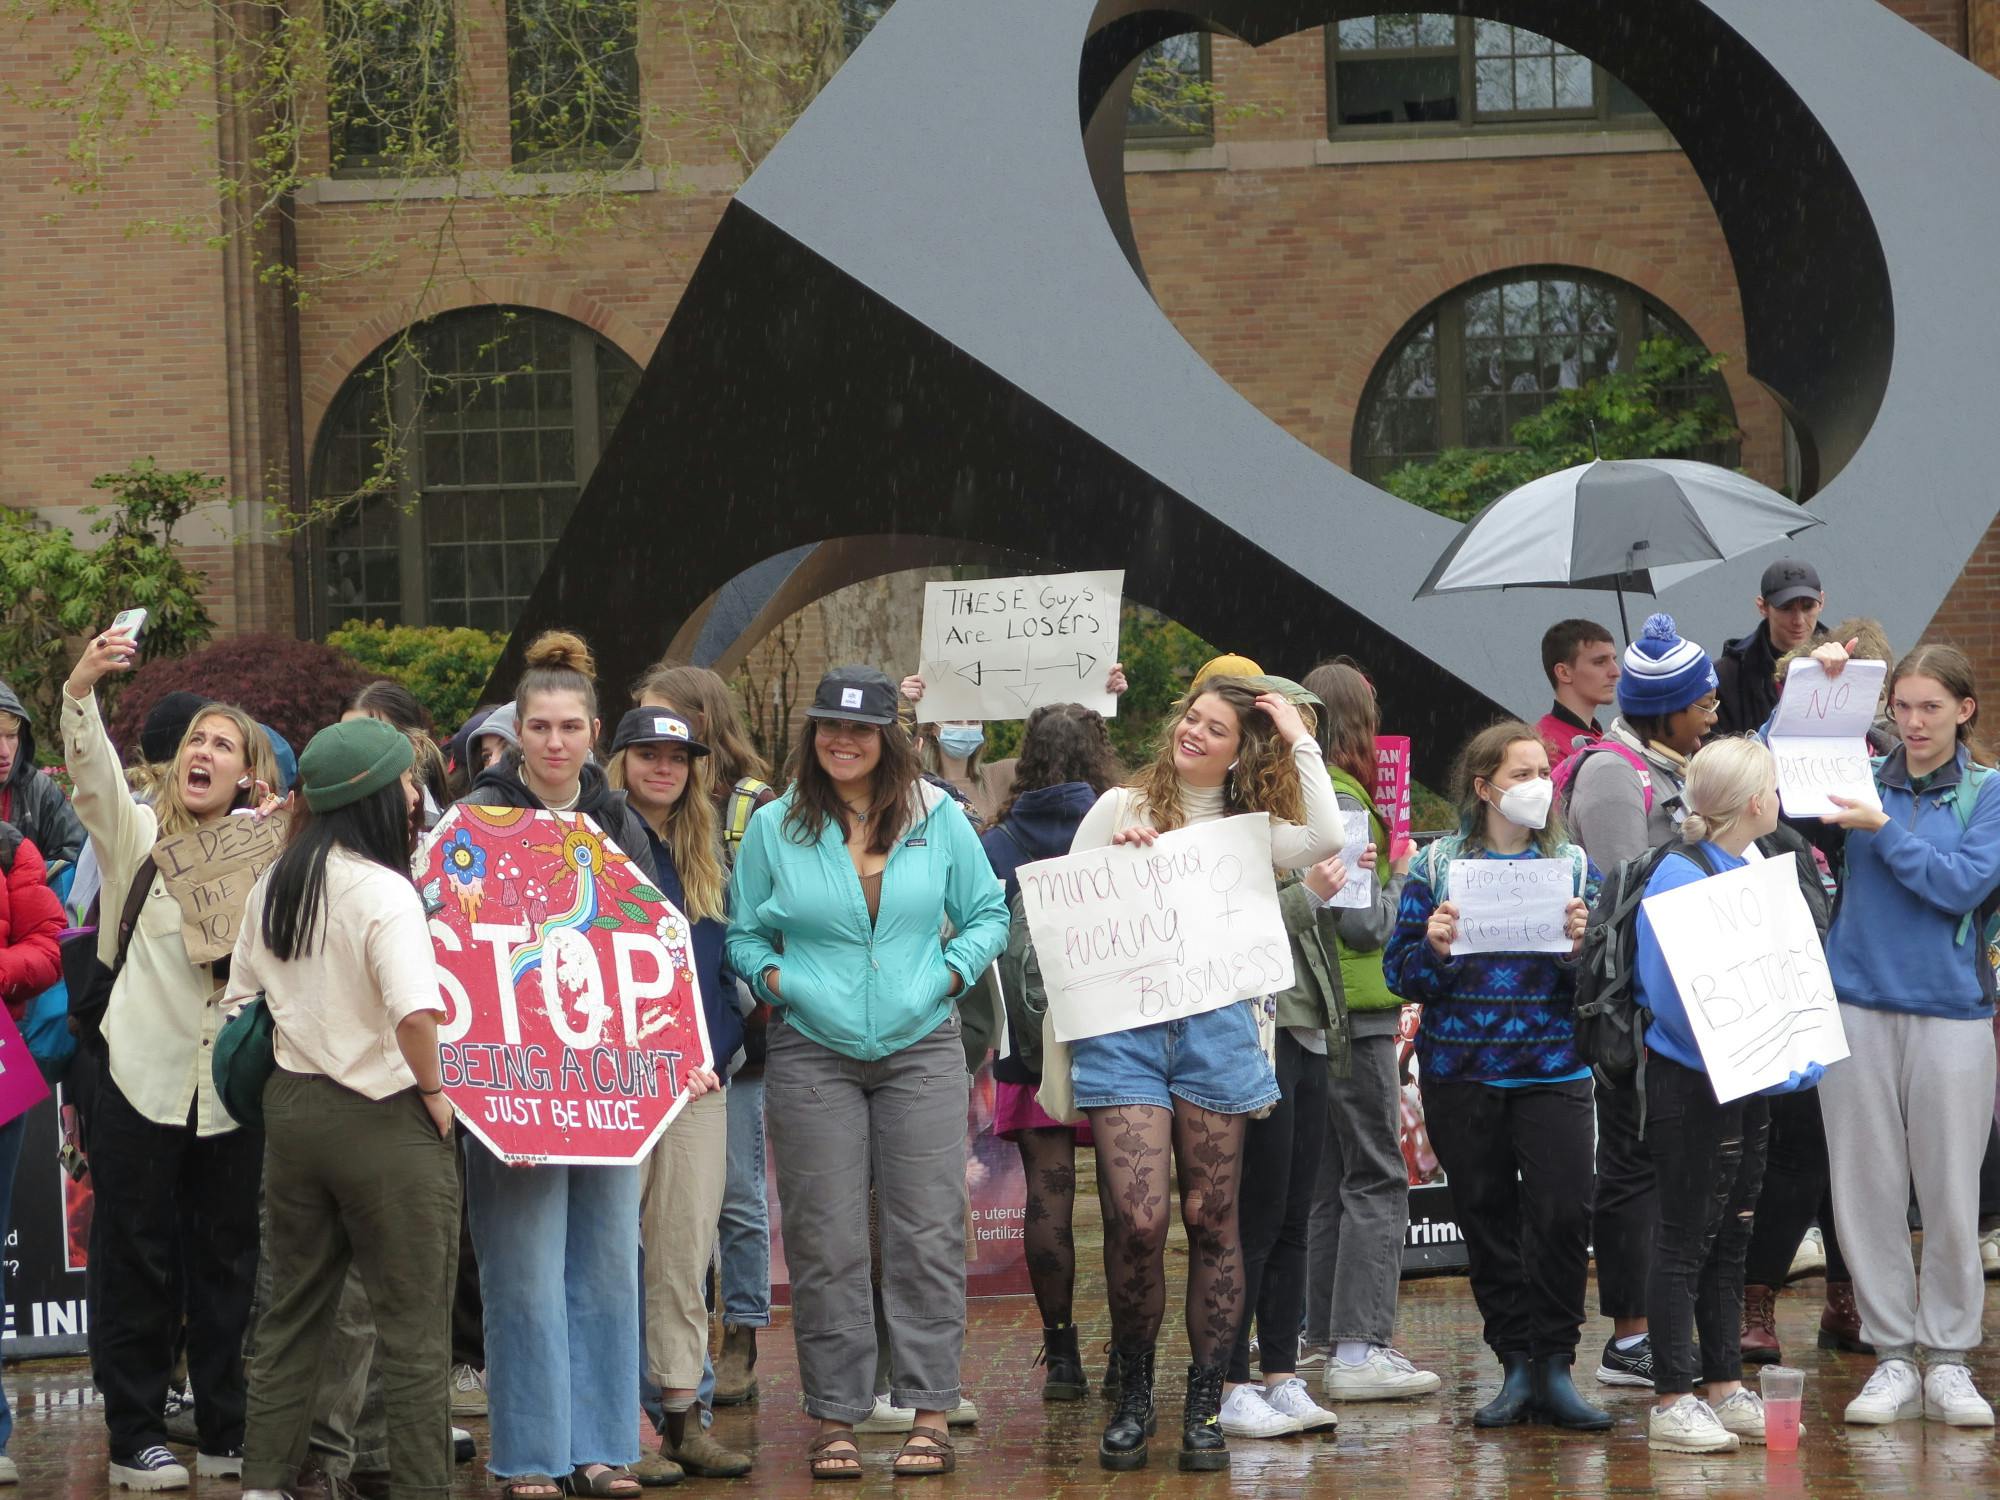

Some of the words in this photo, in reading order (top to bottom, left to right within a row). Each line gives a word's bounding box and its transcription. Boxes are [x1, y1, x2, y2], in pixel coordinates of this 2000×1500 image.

[942, 588, 1027, 615] THESE
[1040, 586, 1094, 623] Guys
[945, 625, 992, 645] Are
[1805, 682, 1849, 720] NO
[161, 838, 194, 878] I
[197, 913, 231, 945] TO
[1708, 888, 1762, 934] NO
[428, 918, 675, 1050] STOP
[1130, 943, 1284, 1018] BUSINESS
[1691, 939, 1835, 1031] BITCHES
[438, 1042, 552, 1090] BEING
[560, 1046, 588, 1091] A
[591, 1047, 682, 1100] CUNT
[484, 1095, 541, 1126] JUST
[550, 1099, 582, 1128] BE
[586, 1100, 645, 1131] NICE
